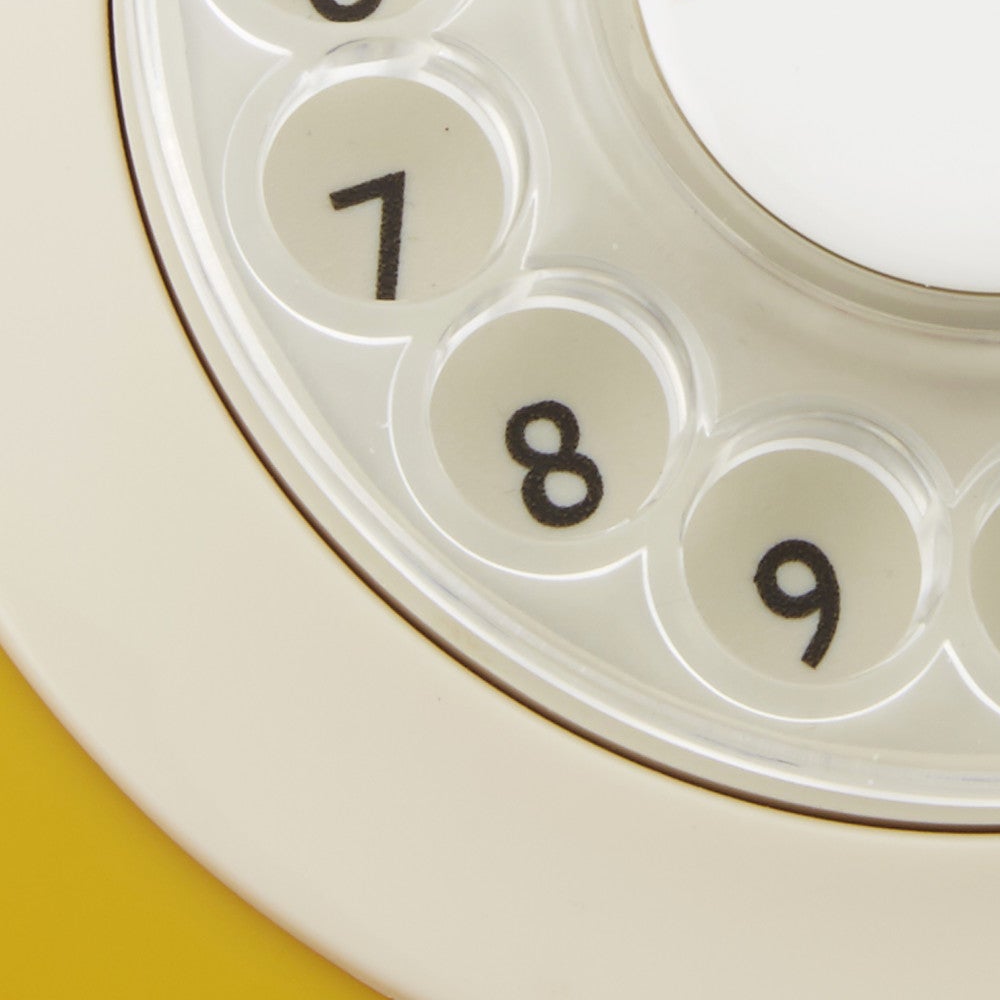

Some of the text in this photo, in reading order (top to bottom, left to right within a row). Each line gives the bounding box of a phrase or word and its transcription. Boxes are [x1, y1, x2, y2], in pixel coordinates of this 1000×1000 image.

[329, 170, 406, 301] 7
[504, 400, 604, 528] 8
[752, 539, 841, 669] 9
